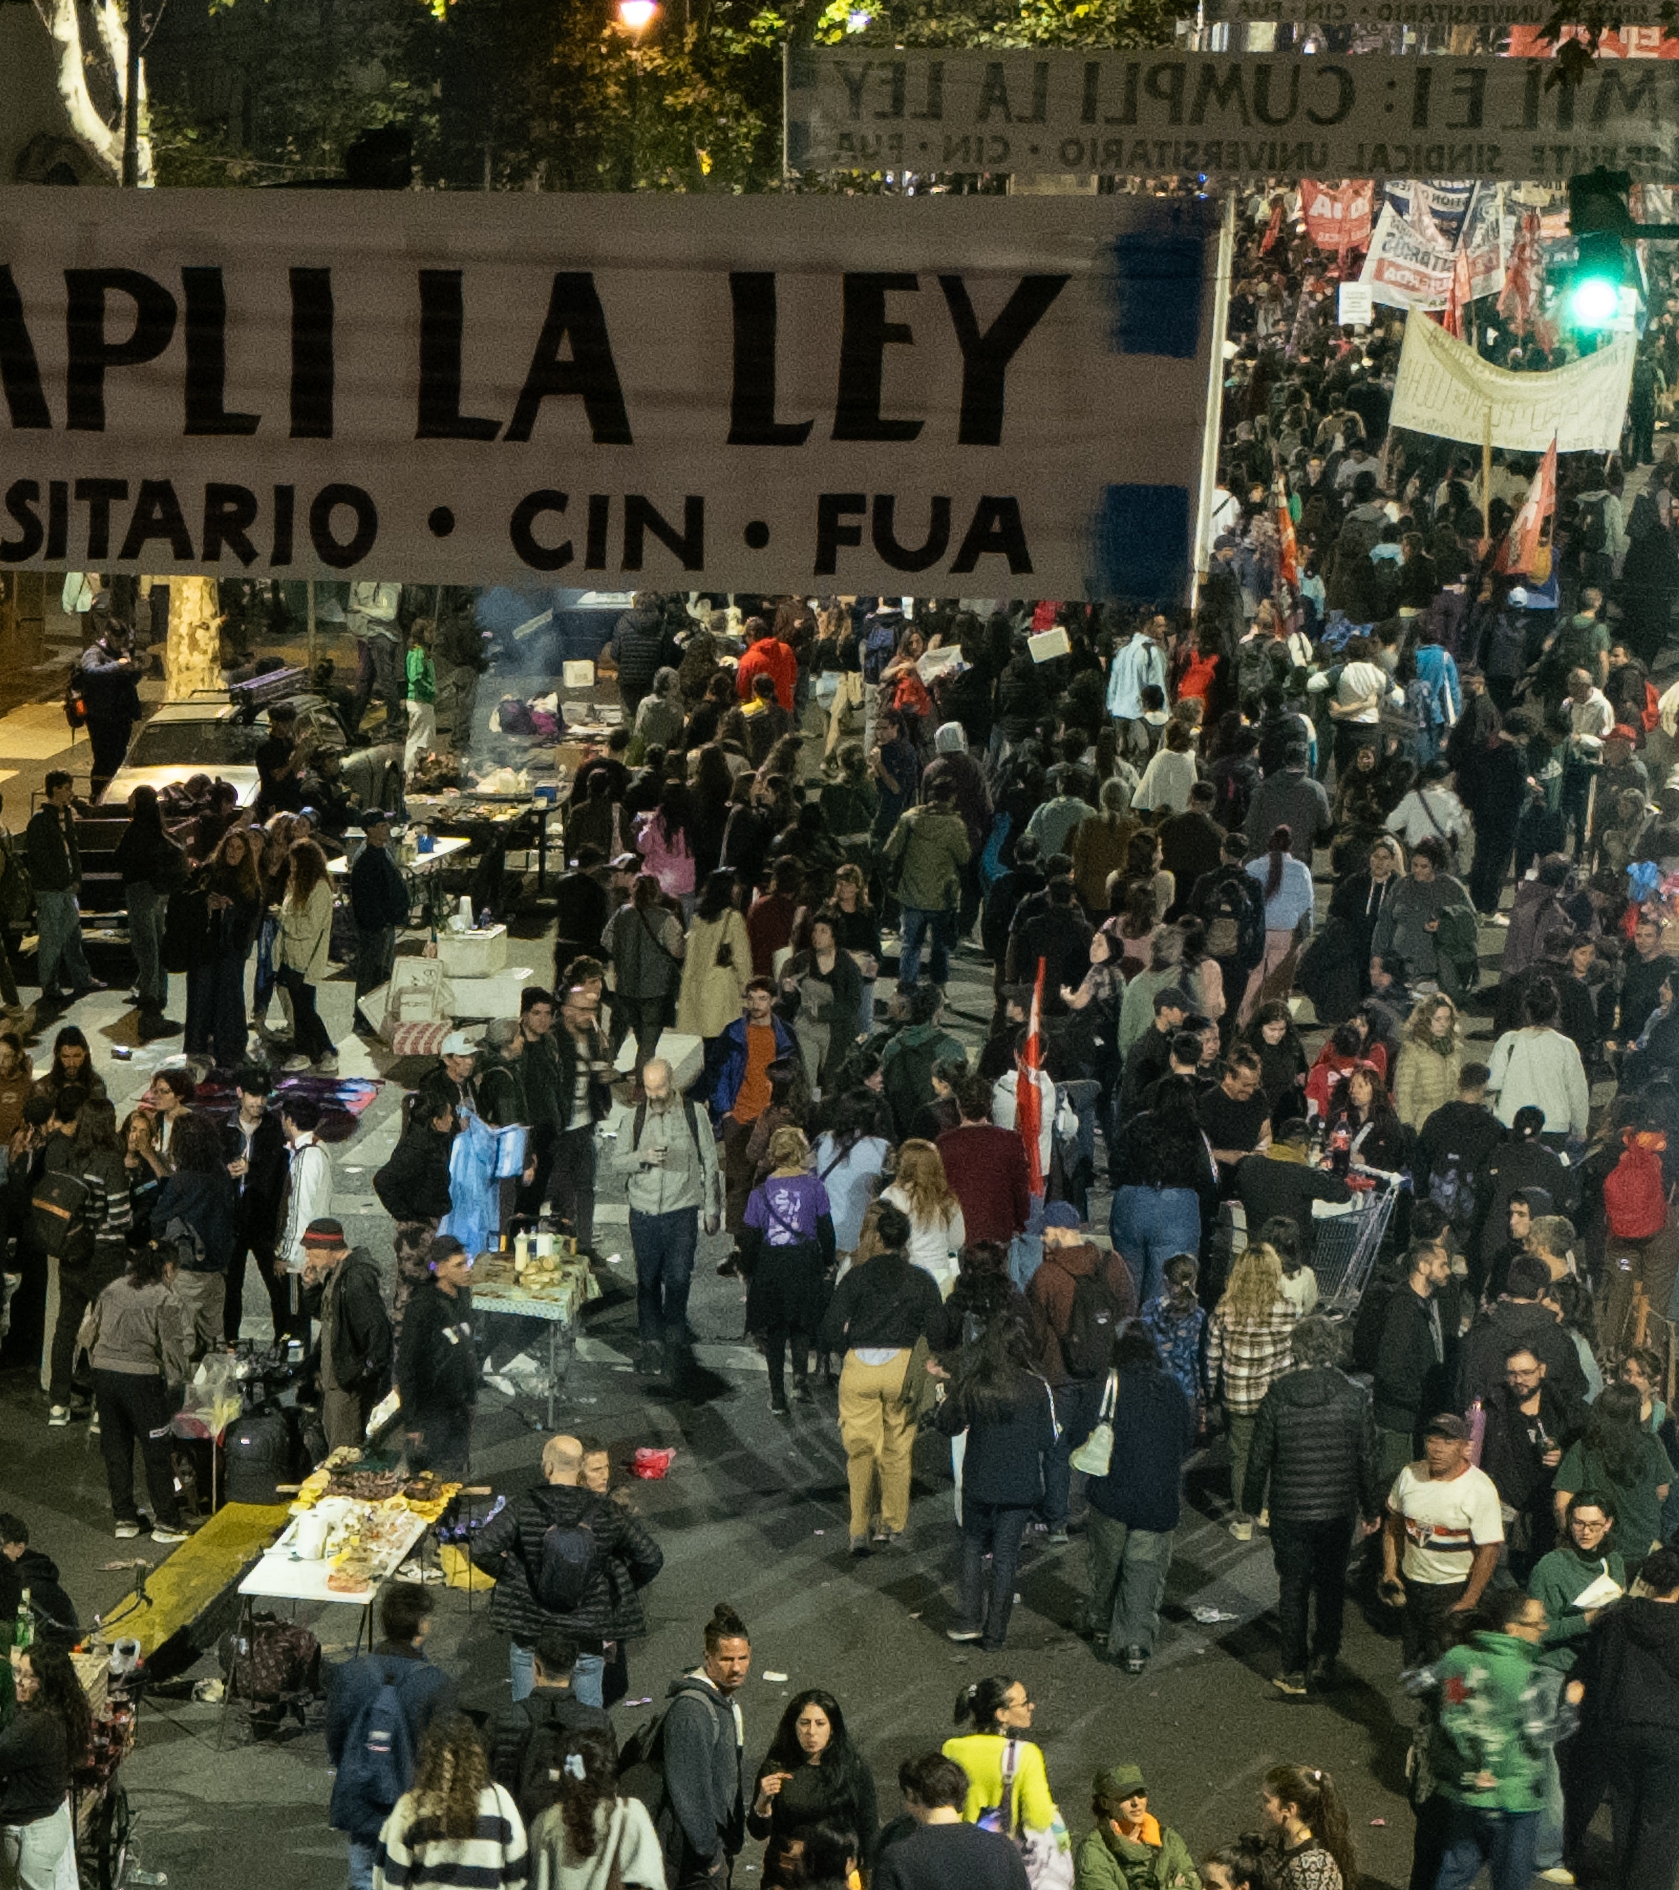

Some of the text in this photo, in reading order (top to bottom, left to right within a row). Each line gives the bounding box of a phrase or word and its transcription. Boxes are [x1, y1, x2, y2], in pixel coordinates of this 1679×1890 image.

[415, 268, 635, 446] LA
[726, 270, 1073, 447] LEY
[509, 488, 706, 573] CIN
[813, 491, 1036, 576] FUA
